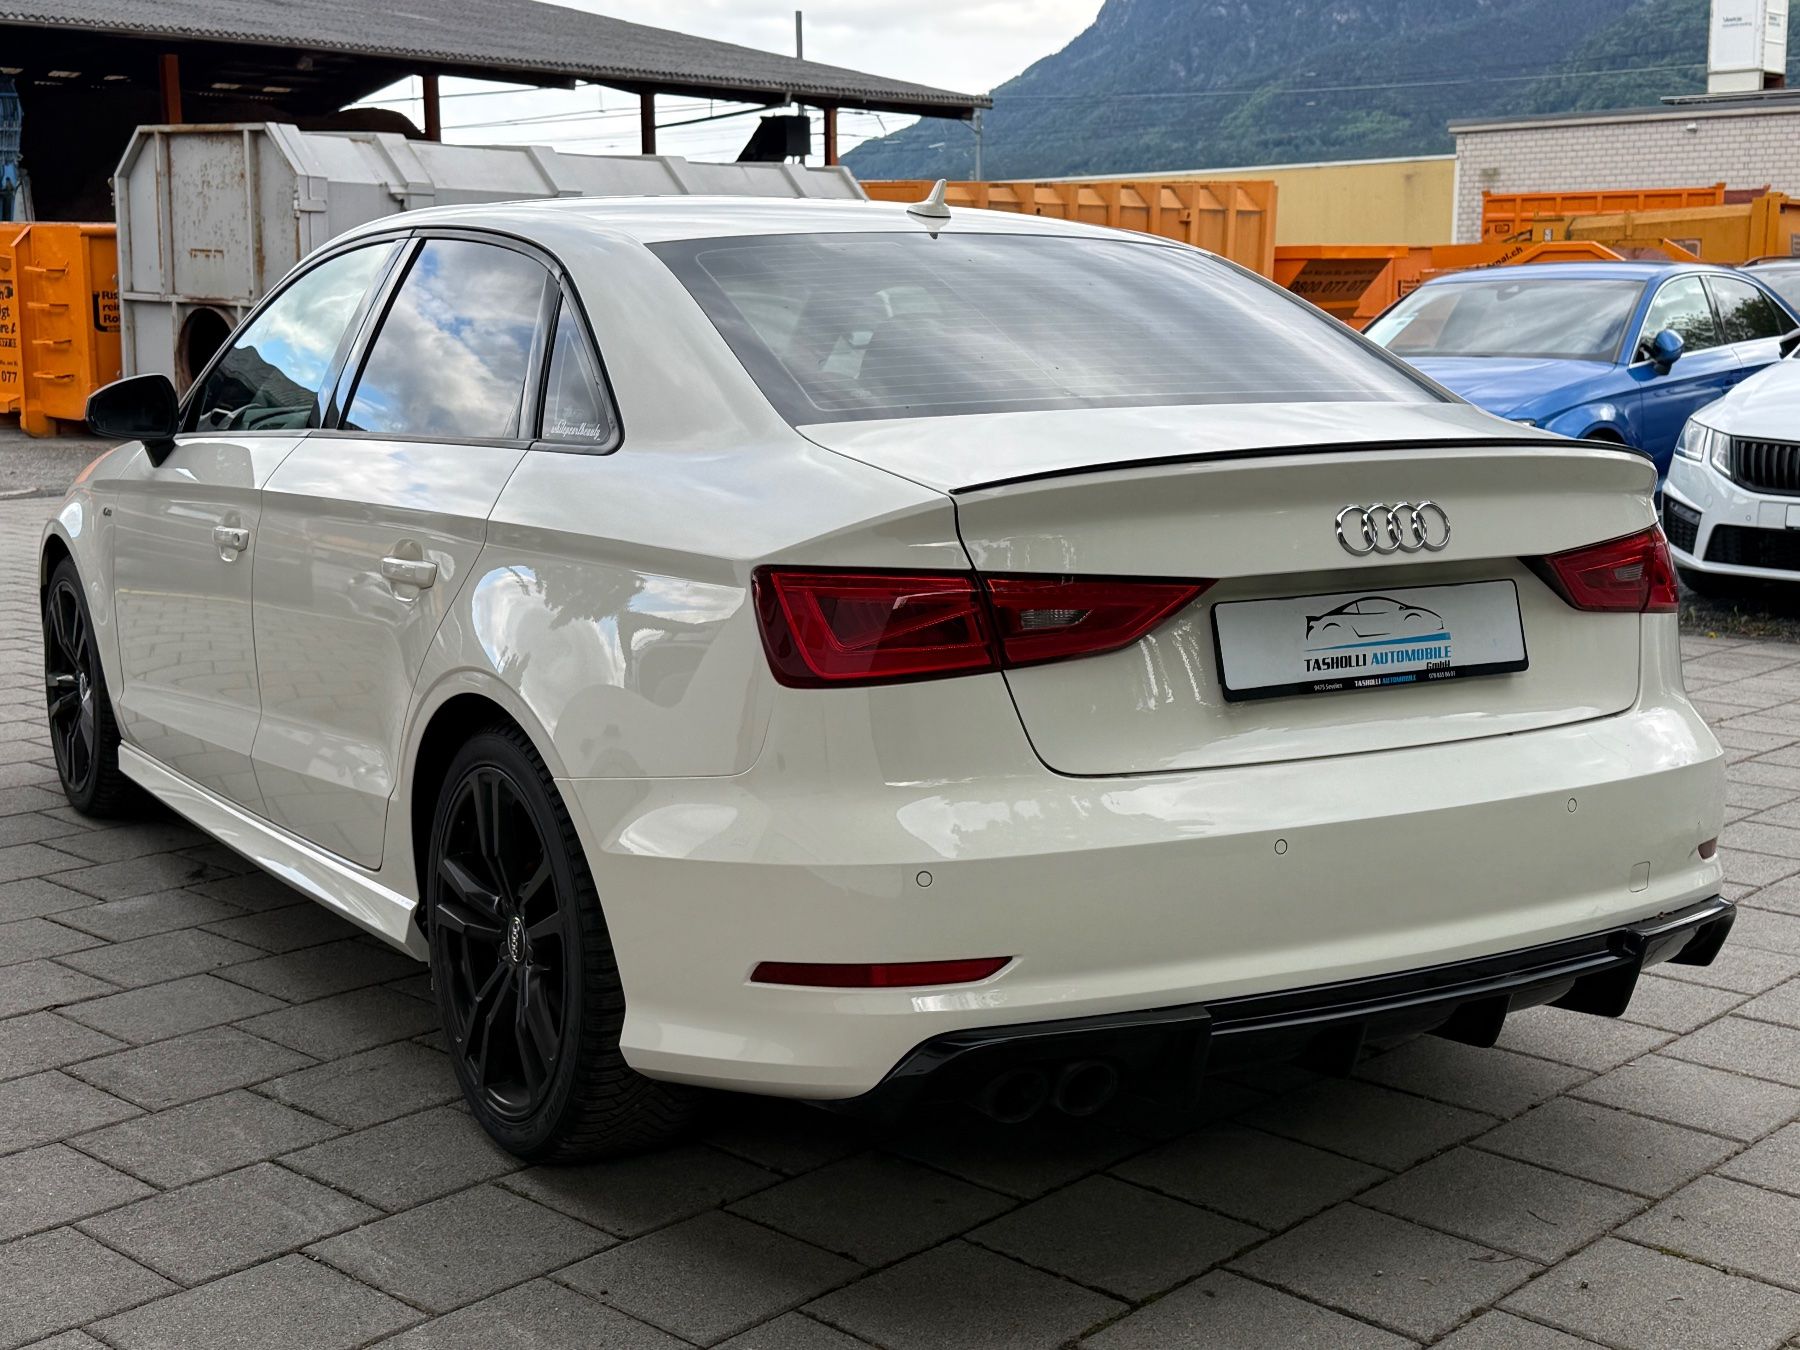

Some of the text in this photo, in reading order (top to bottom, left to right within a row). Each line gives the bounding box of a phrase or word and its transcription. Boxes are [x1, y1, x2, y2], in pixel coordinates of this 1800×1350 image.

[1304, 645, 1452, 672] TASHOLLI AUTOMOBILE
[1426, 660, 1450, 670] GmbH
[1354, 678, 1381, 687] TASHOLLI
[1382, 674, 1417, 684] AUTOMOBILE
